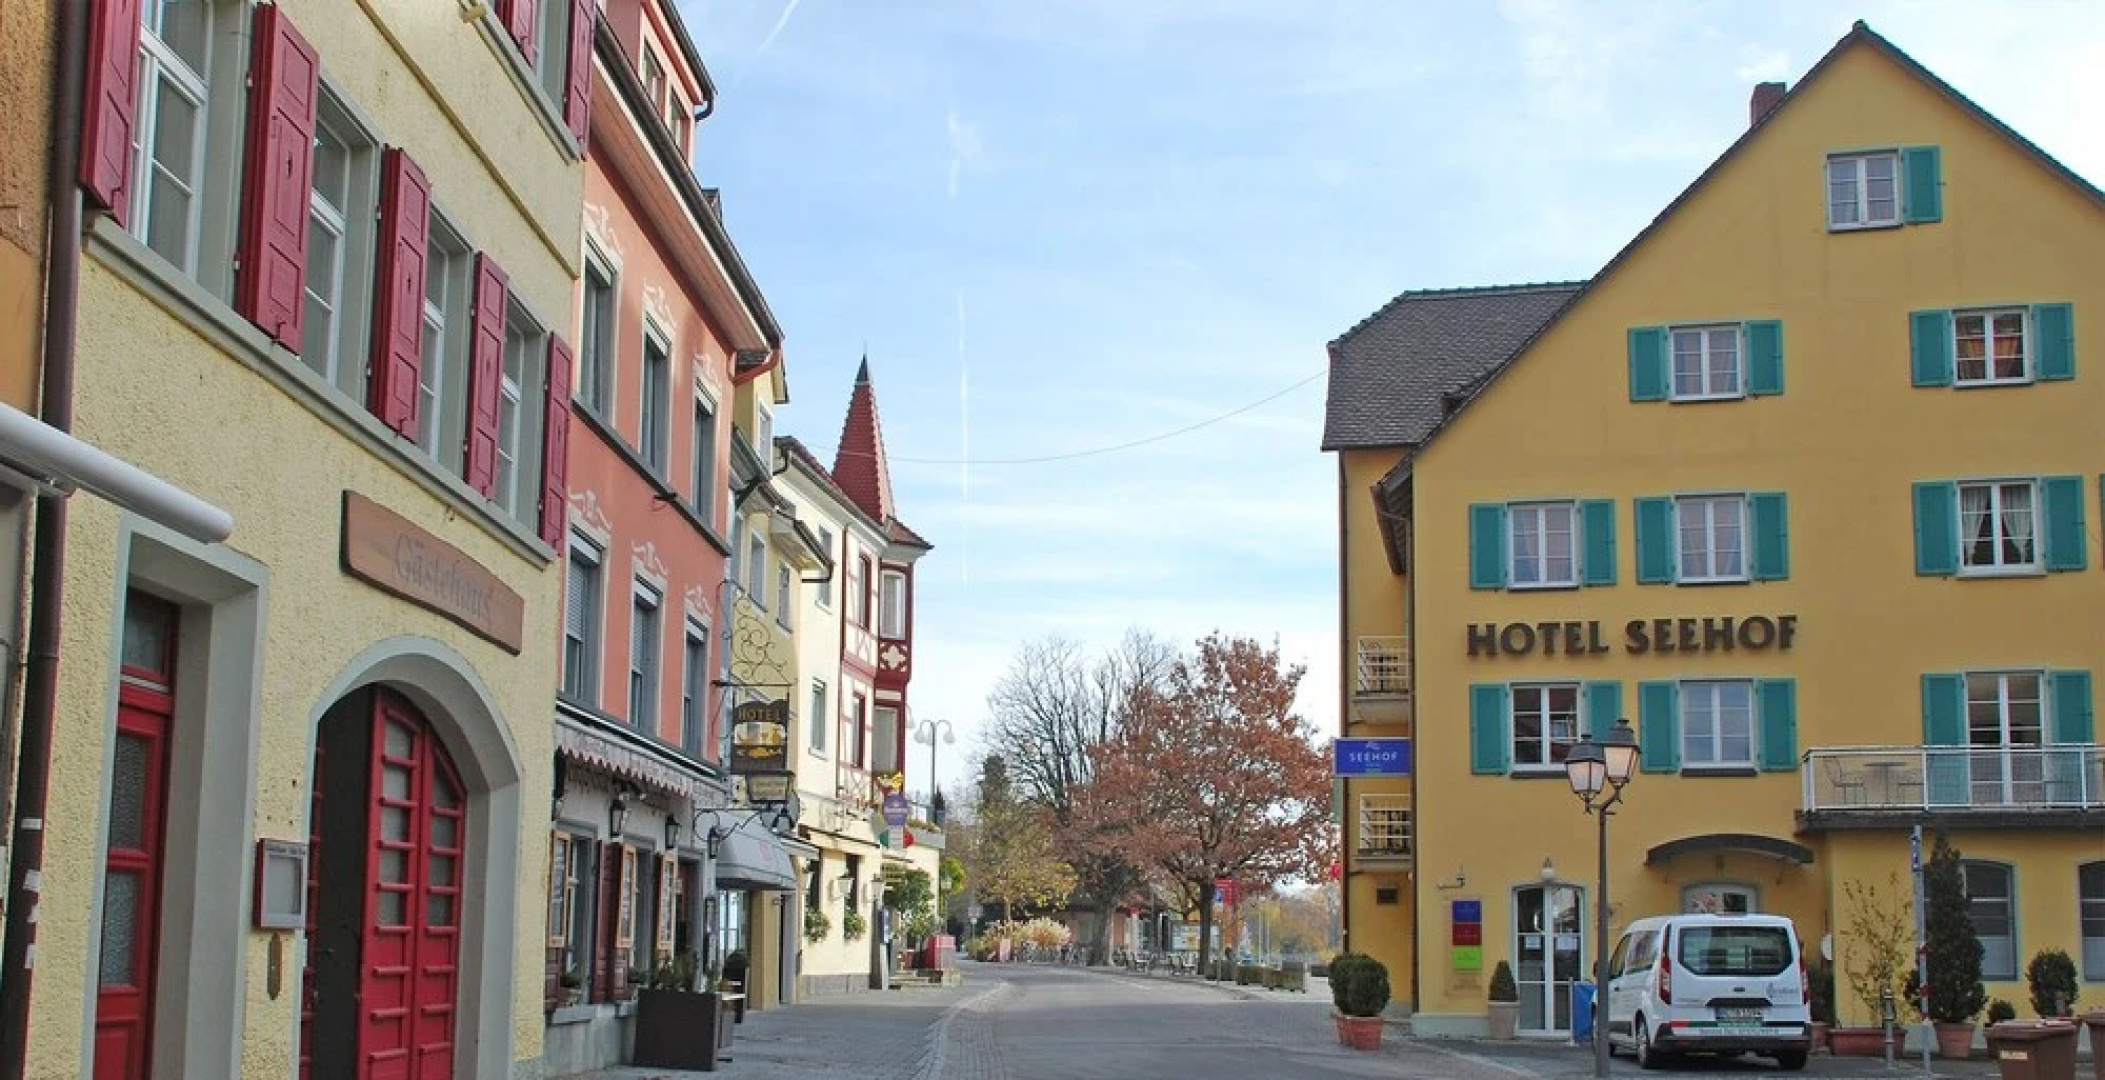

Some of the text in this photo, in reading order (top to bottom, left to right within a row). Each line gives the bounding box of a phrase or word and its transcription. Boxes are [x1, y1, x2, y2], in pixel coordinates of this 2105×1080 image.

[393, 533, 491, 621] Gästehaus
[1467, 615, 1797, 656] HOTEL SEEHOF
[738, 707, 782, 721] HOTEL
[1348, 751, 1398, 763] SEEHOF
